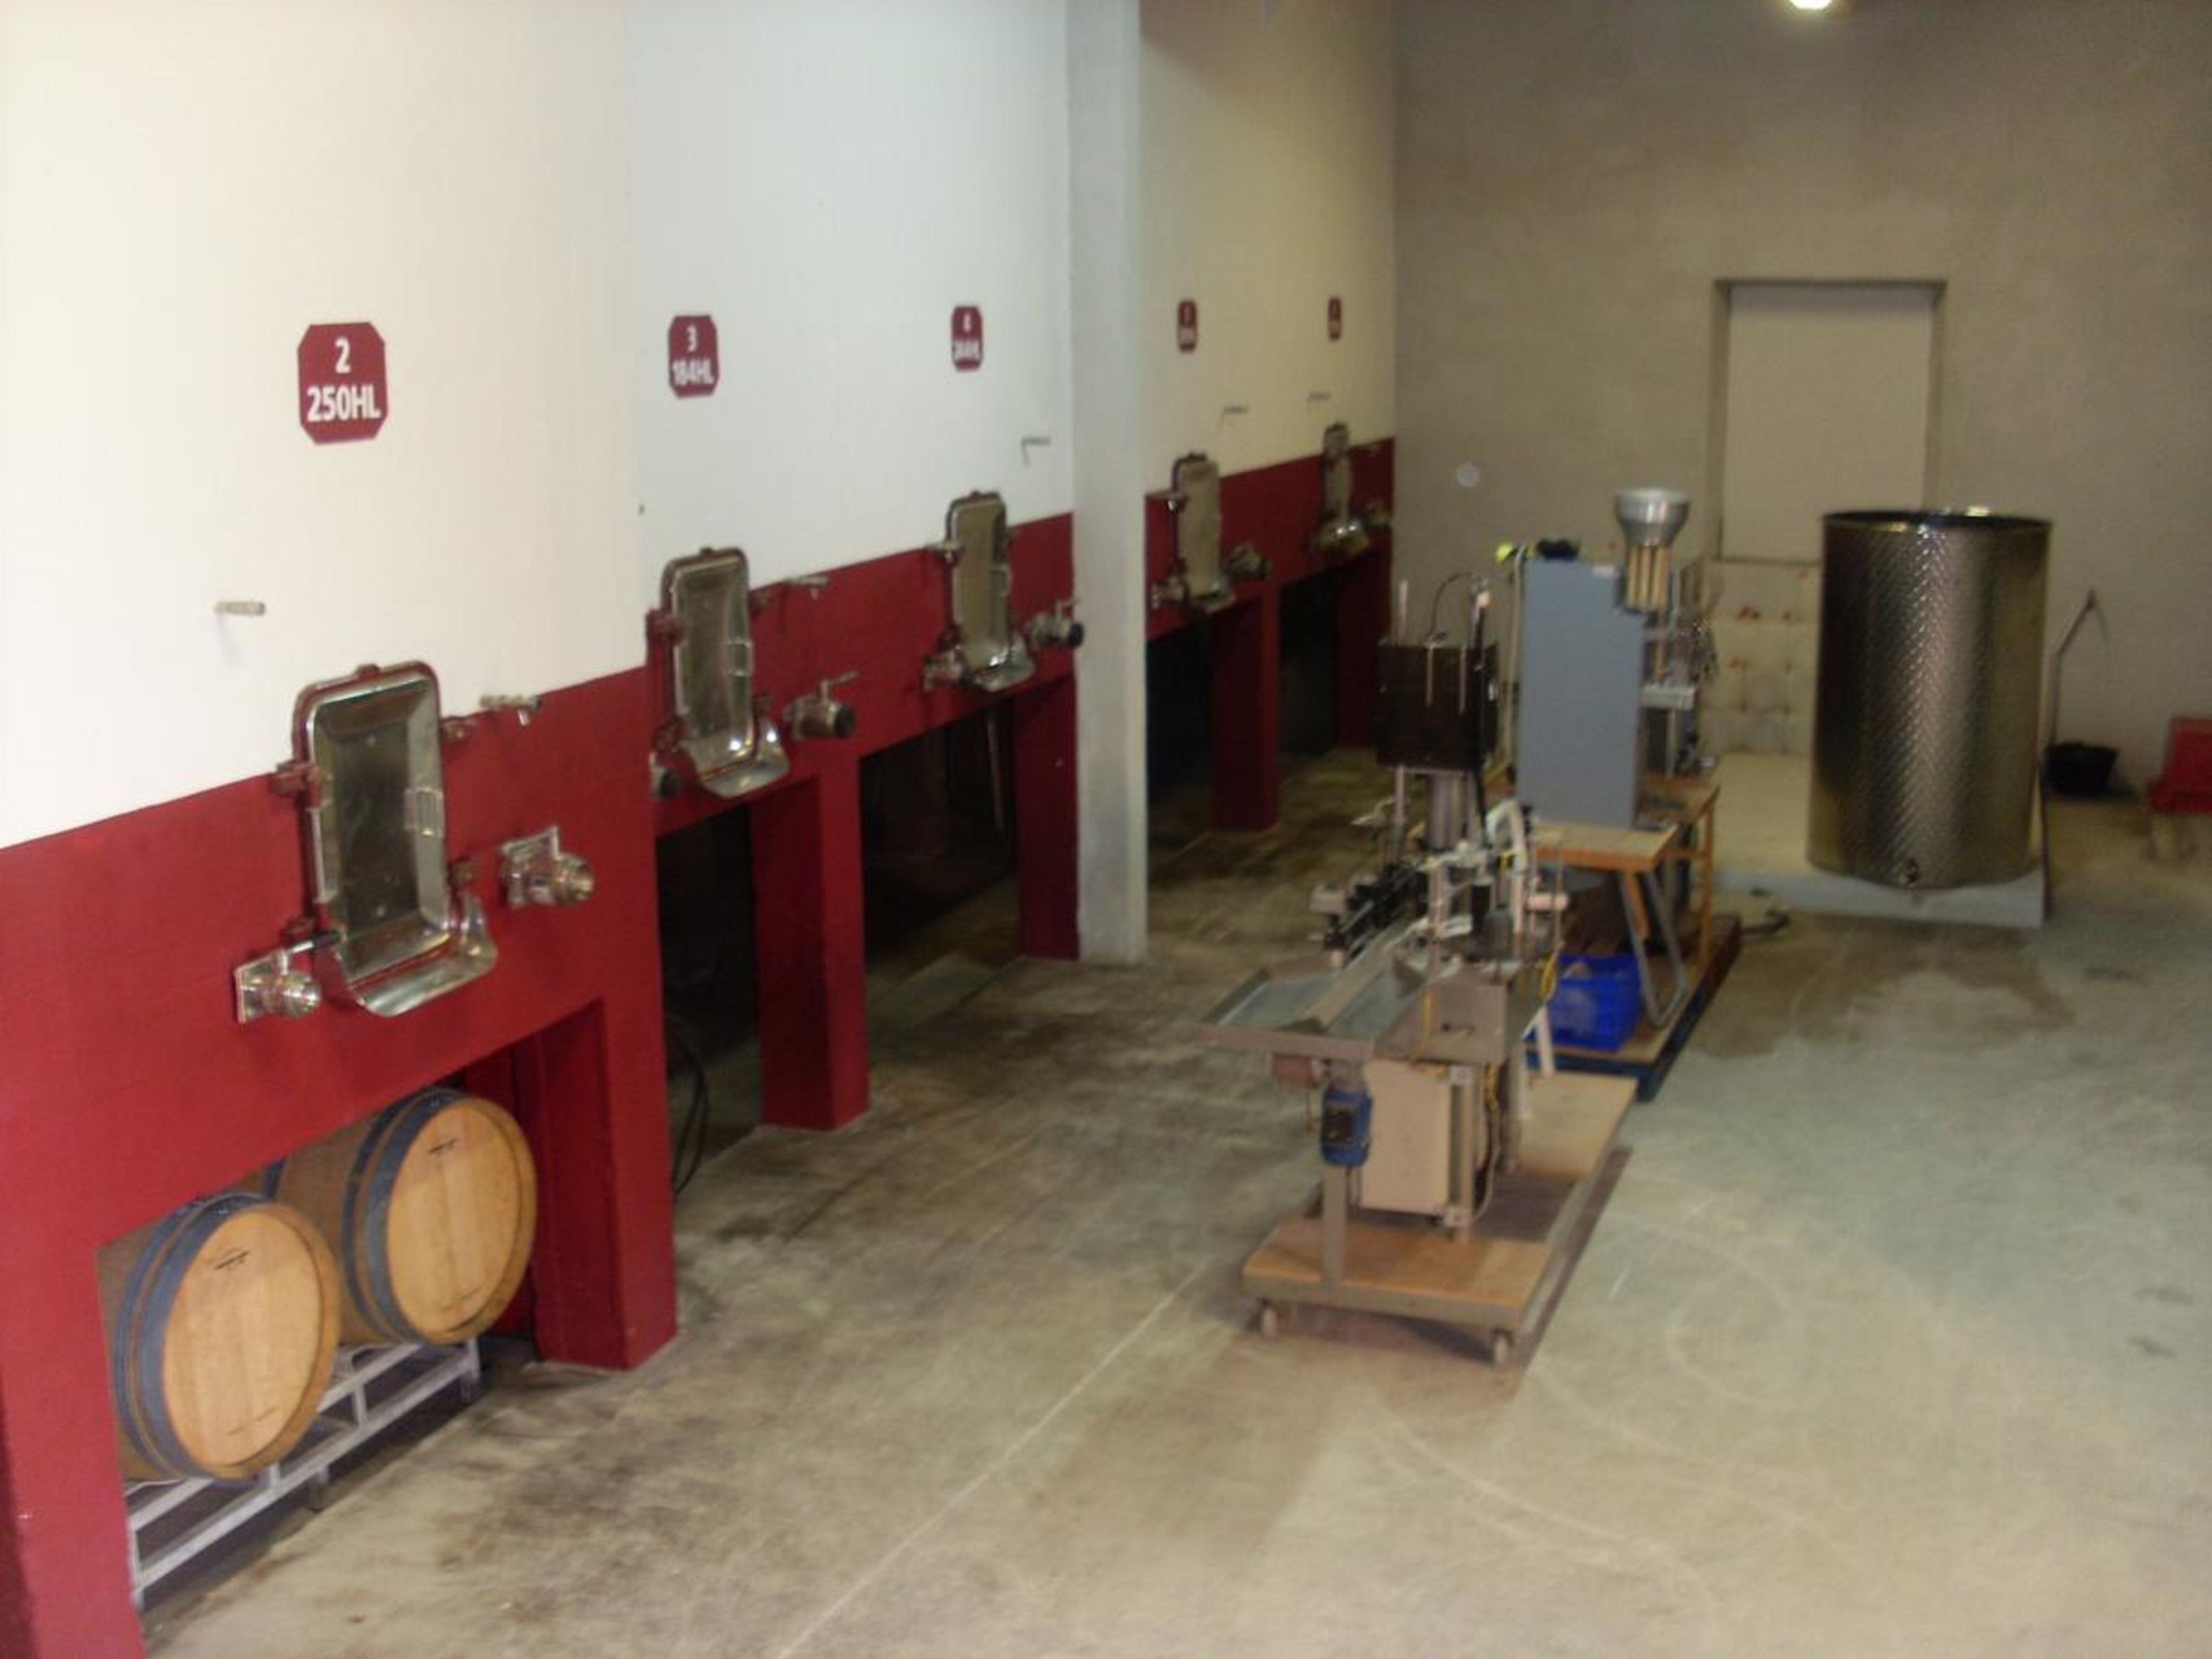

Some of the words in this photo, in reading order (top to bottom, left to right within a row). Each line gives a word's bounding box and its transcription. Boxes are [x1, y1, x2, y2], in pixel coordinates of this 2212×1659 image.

[335, 336, 351, 373] 2
[687, 324, 697, 353] 3
[306, 383, 381, 422] 250HL
